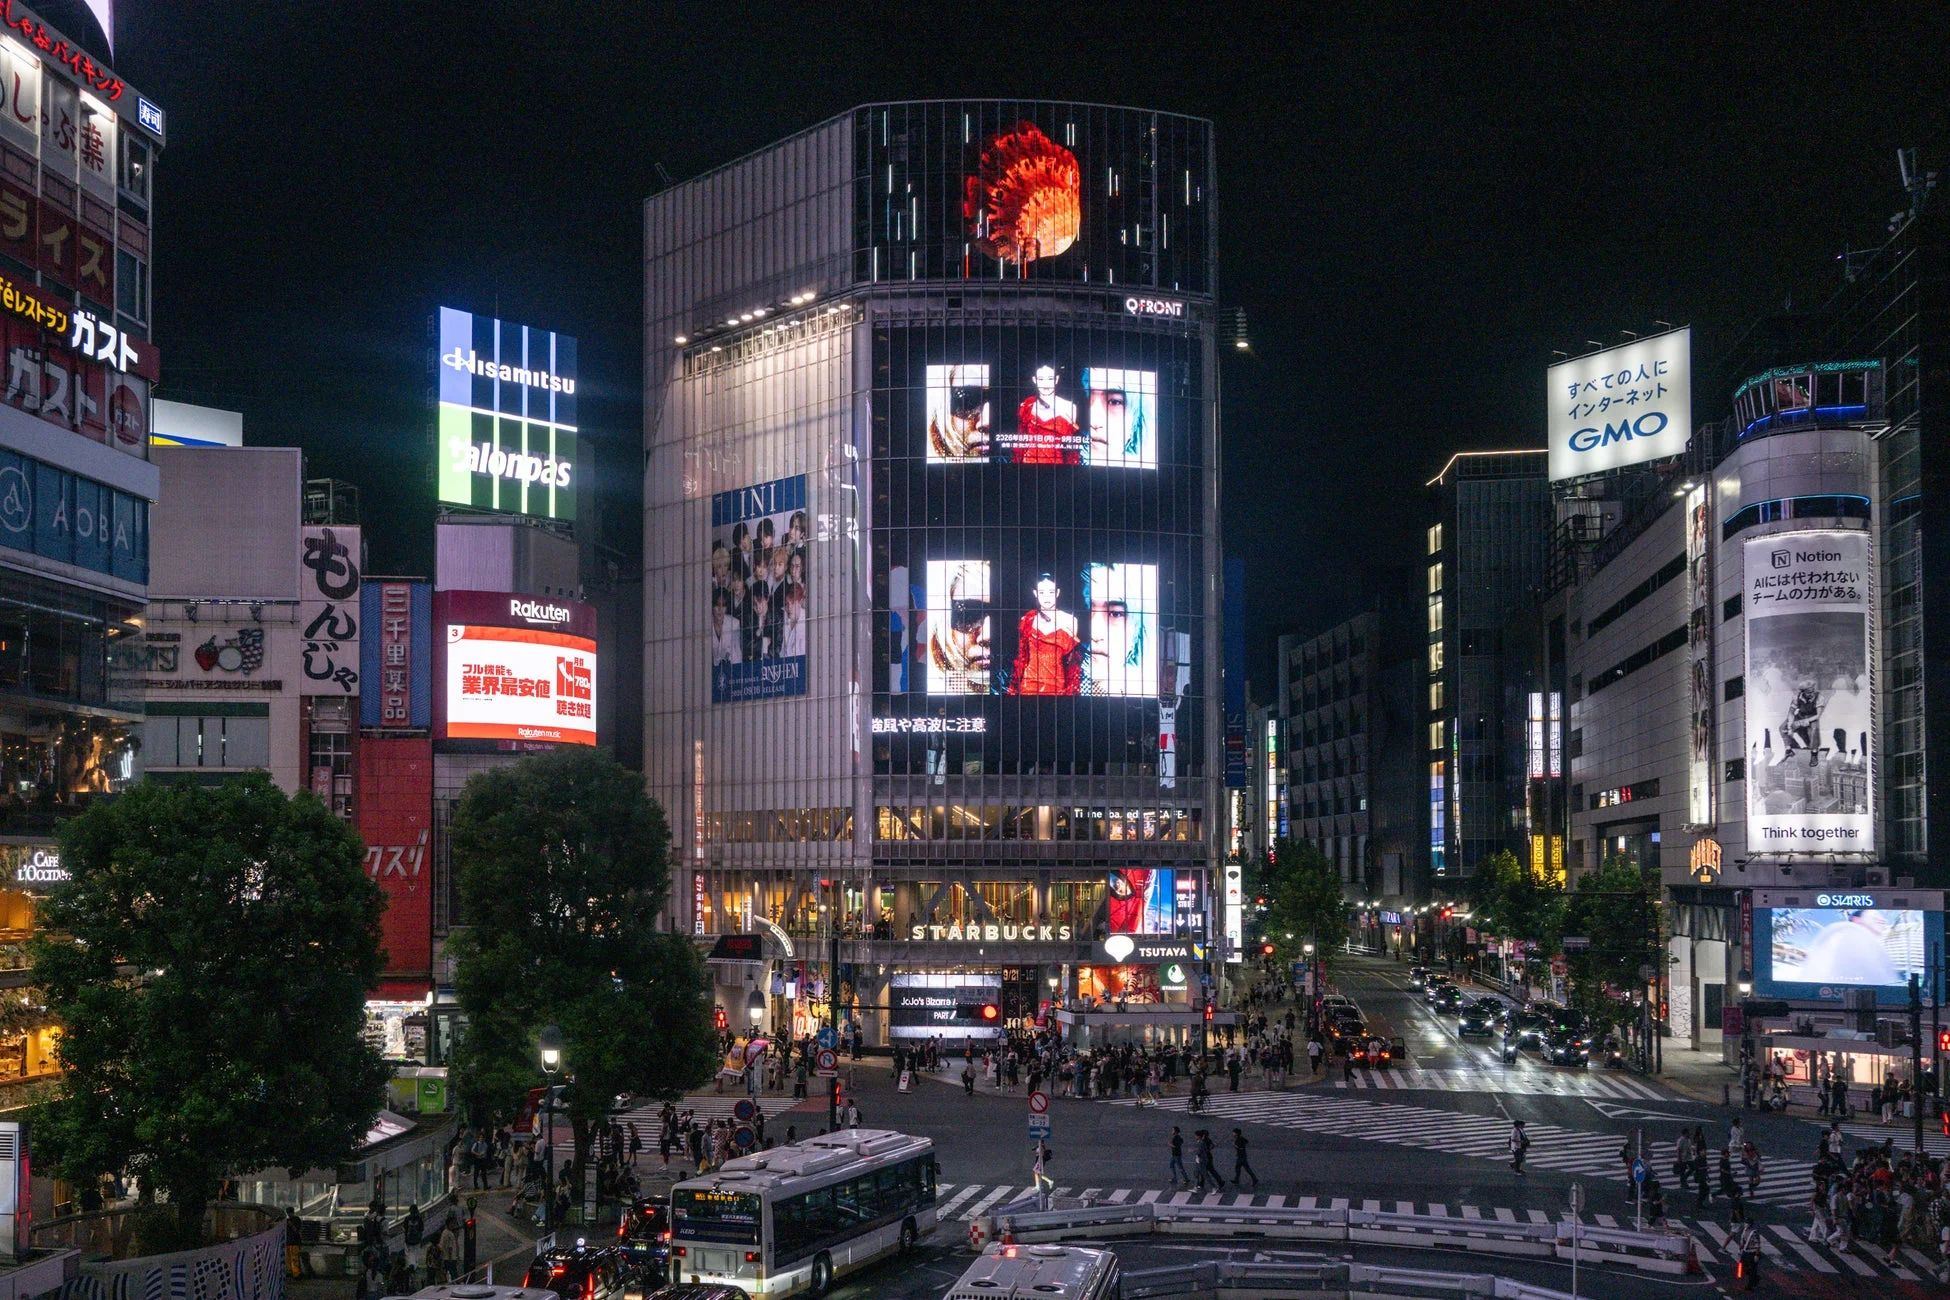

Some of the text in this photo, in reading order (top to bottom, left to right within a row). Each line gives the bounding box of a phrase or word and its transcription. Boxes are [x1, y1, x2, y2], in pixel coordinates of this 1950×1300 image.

[139, 103, 162, 131] 寿司
[1126, 297, 1182, 316] QFRONT
[71, 309, 139, 373] ガスト
[442, 347, 575, 395] Hisamitsu
[1567, 360, 1668, 400] すべての人に
[6, 348, 98, 430] ガスト
[1568, 382, 1668, 420] インターネット
[1568, 411, 1668, 452] GMO
[447, 435, 572, 488] Salonpas
[738, 483, 777, 519] INI
[52, 500, 130, 551] AOBA
[1796, 550, 1842, 563] Notion
[1754, 571, 1860, 590] AIには代われない
[1752, 585, 1862, 605] チームの力がある。
[303, 527, 360, 693] もんじゃ
[511, 599, 570, 624] Rakuten
[451, 628, 459, 638] 3
[384, 588, 408, 720] 三千里薬品
[462, 663, 513, 676] フル機能も
[462, 675, 551, 698] 業界最安値
[556, 699, 592, 719] 聴き放題
[518, 727, 546, 738] Rakuten
[872, 717, 986, 733] 強風や高波に注意
[1761, 826, 1860, 841] Think together
[362, 828, 430, 877] クスリ
[912, 925, 1071, 940] STARBUCKS
[1138, 947, 1187, 957] TSUTAYA
